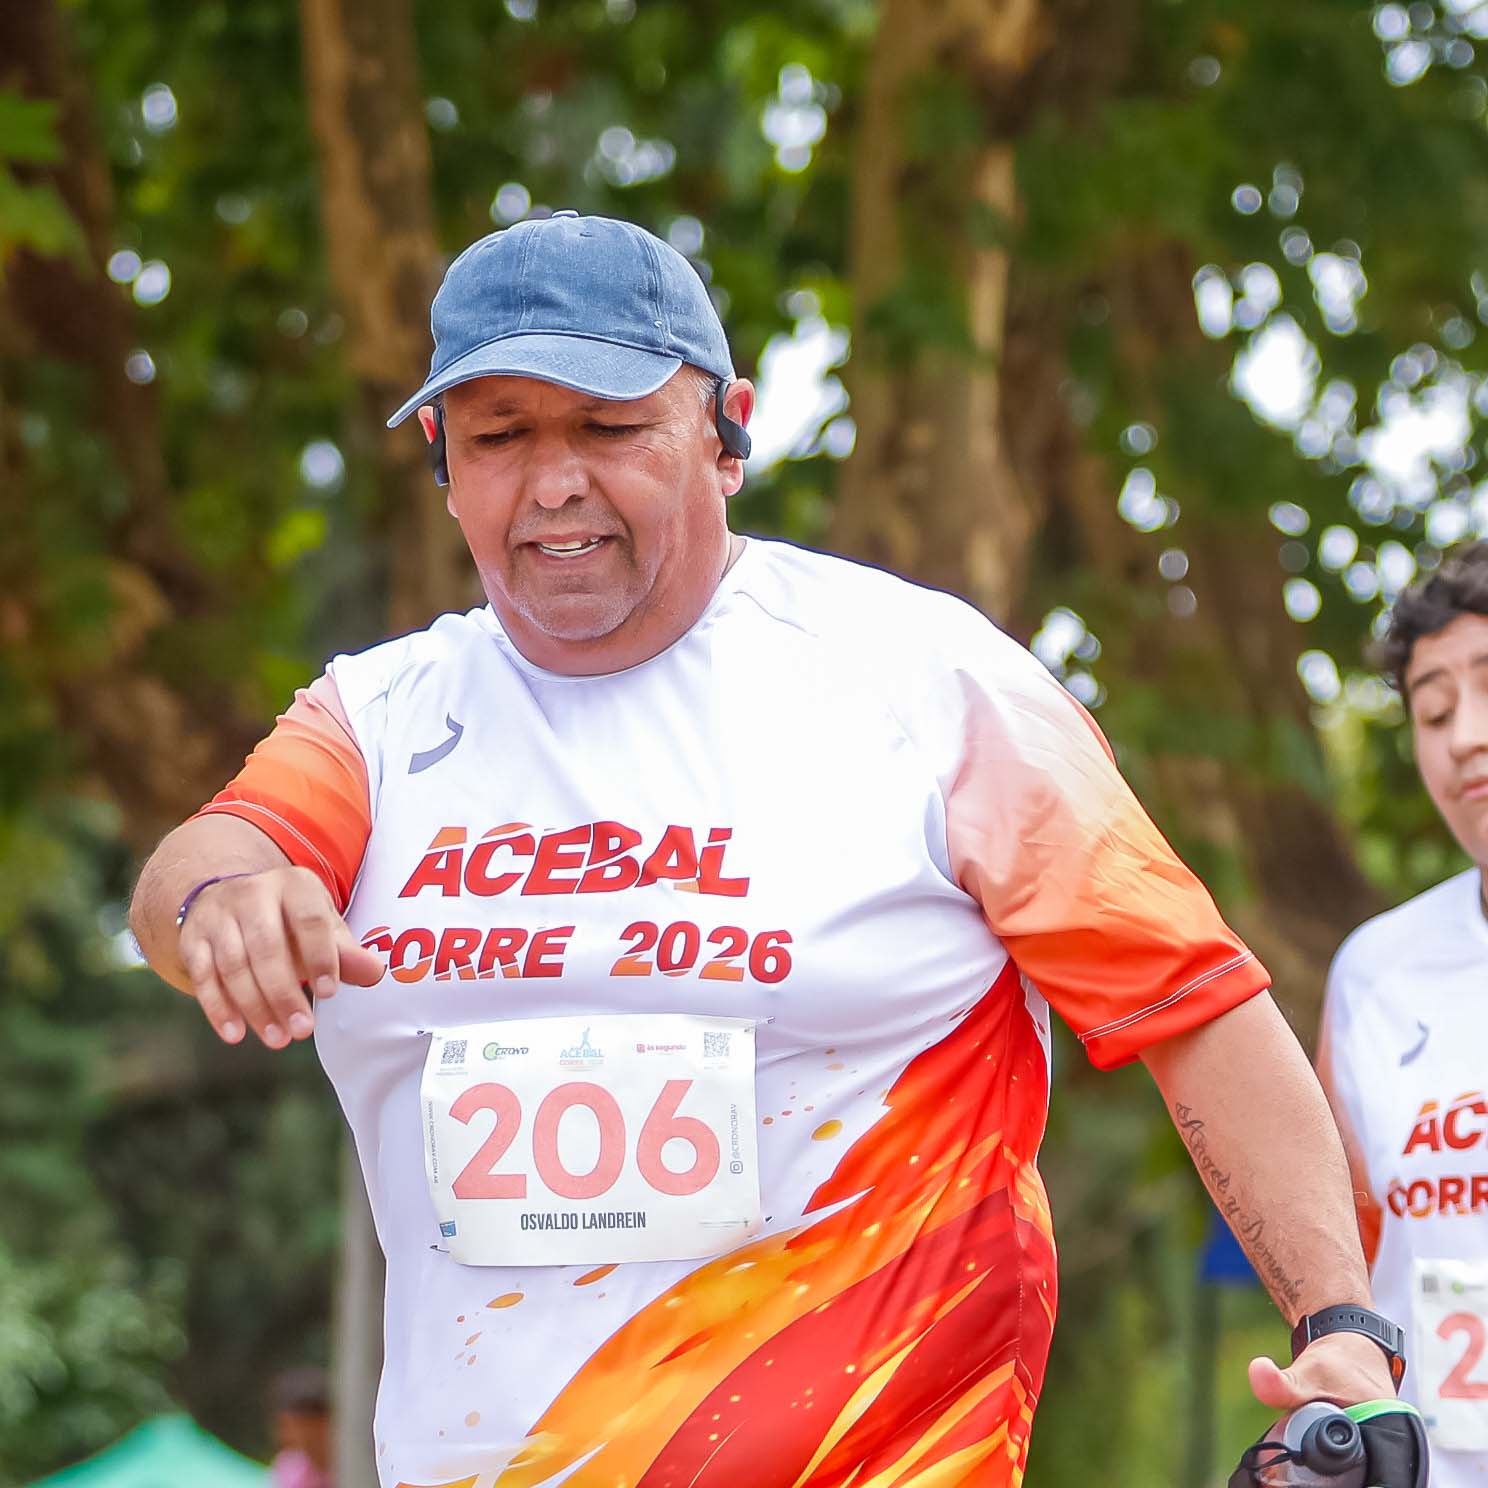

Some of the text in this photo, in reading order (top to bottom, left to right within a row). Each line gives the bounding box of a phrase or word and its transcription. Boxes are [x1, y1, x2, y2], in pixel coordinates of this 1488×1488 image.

[398, 821, 750, 898] ACEBAL
[610, 920, 794, 984] 2026
[449, 1079, 721, 1200] 206
[520, 1211, 647, 1232] OSVALDO LANDREIN
